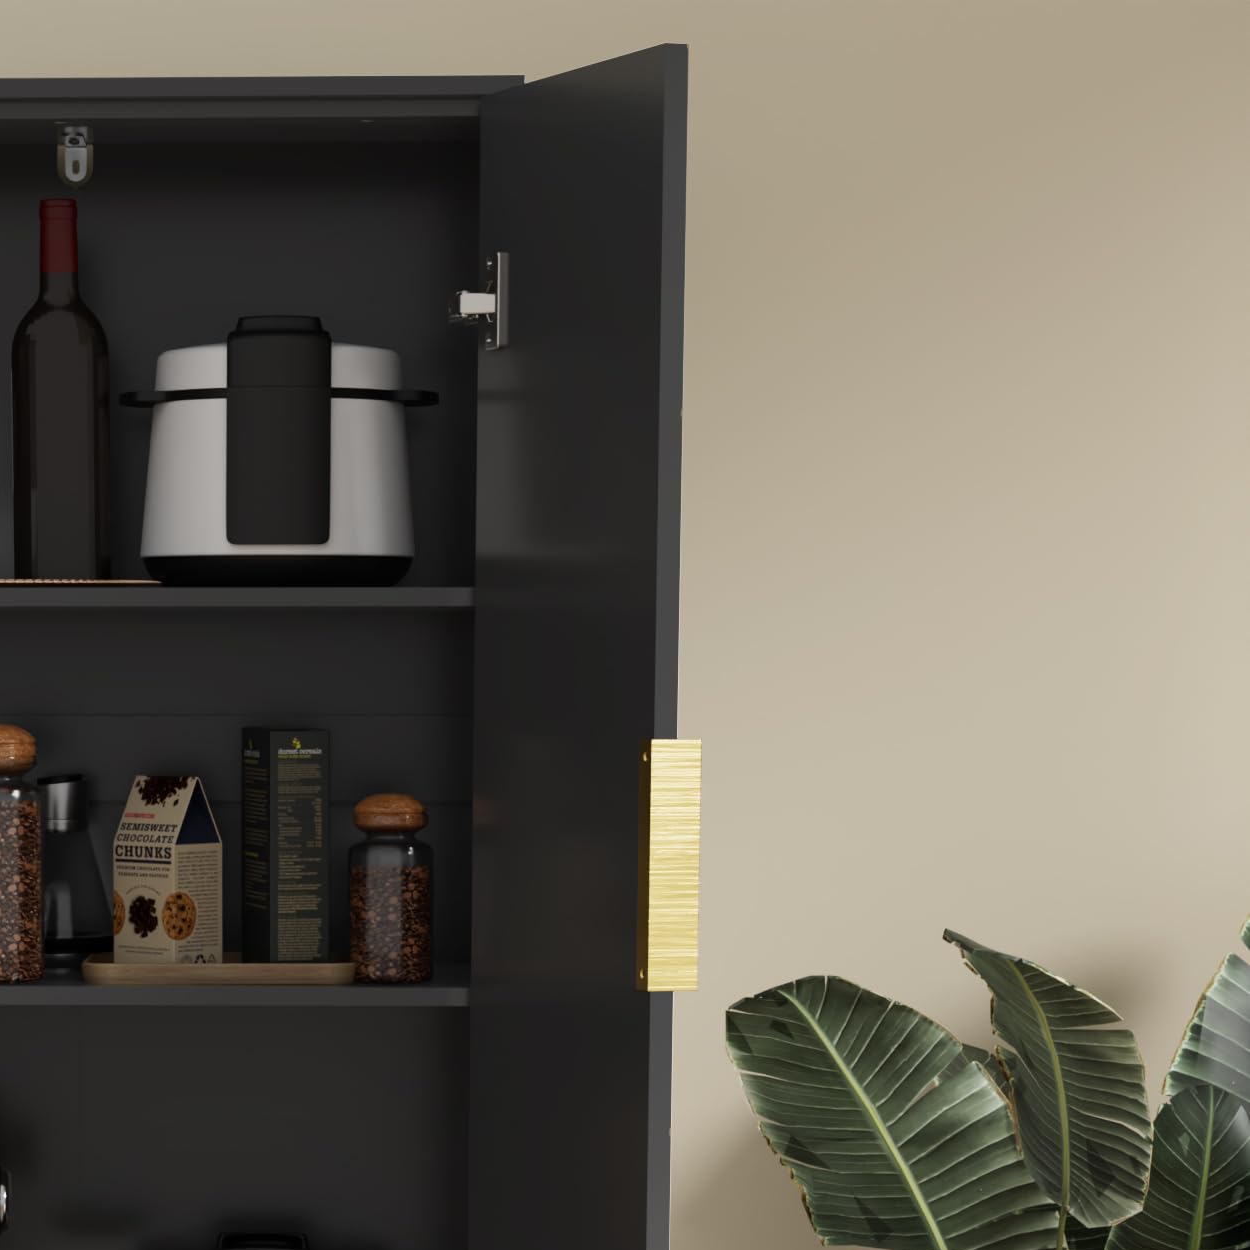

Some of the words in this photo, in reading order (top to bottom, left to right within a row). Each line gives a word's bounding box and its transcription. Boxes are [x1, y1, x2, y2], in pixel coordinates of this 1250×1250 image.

[120, 822, 178, 832] SEMISWEET
[117, 833, 174, 844] CHOCOLATE
[115, 845, 172, 859] CHUNKS
